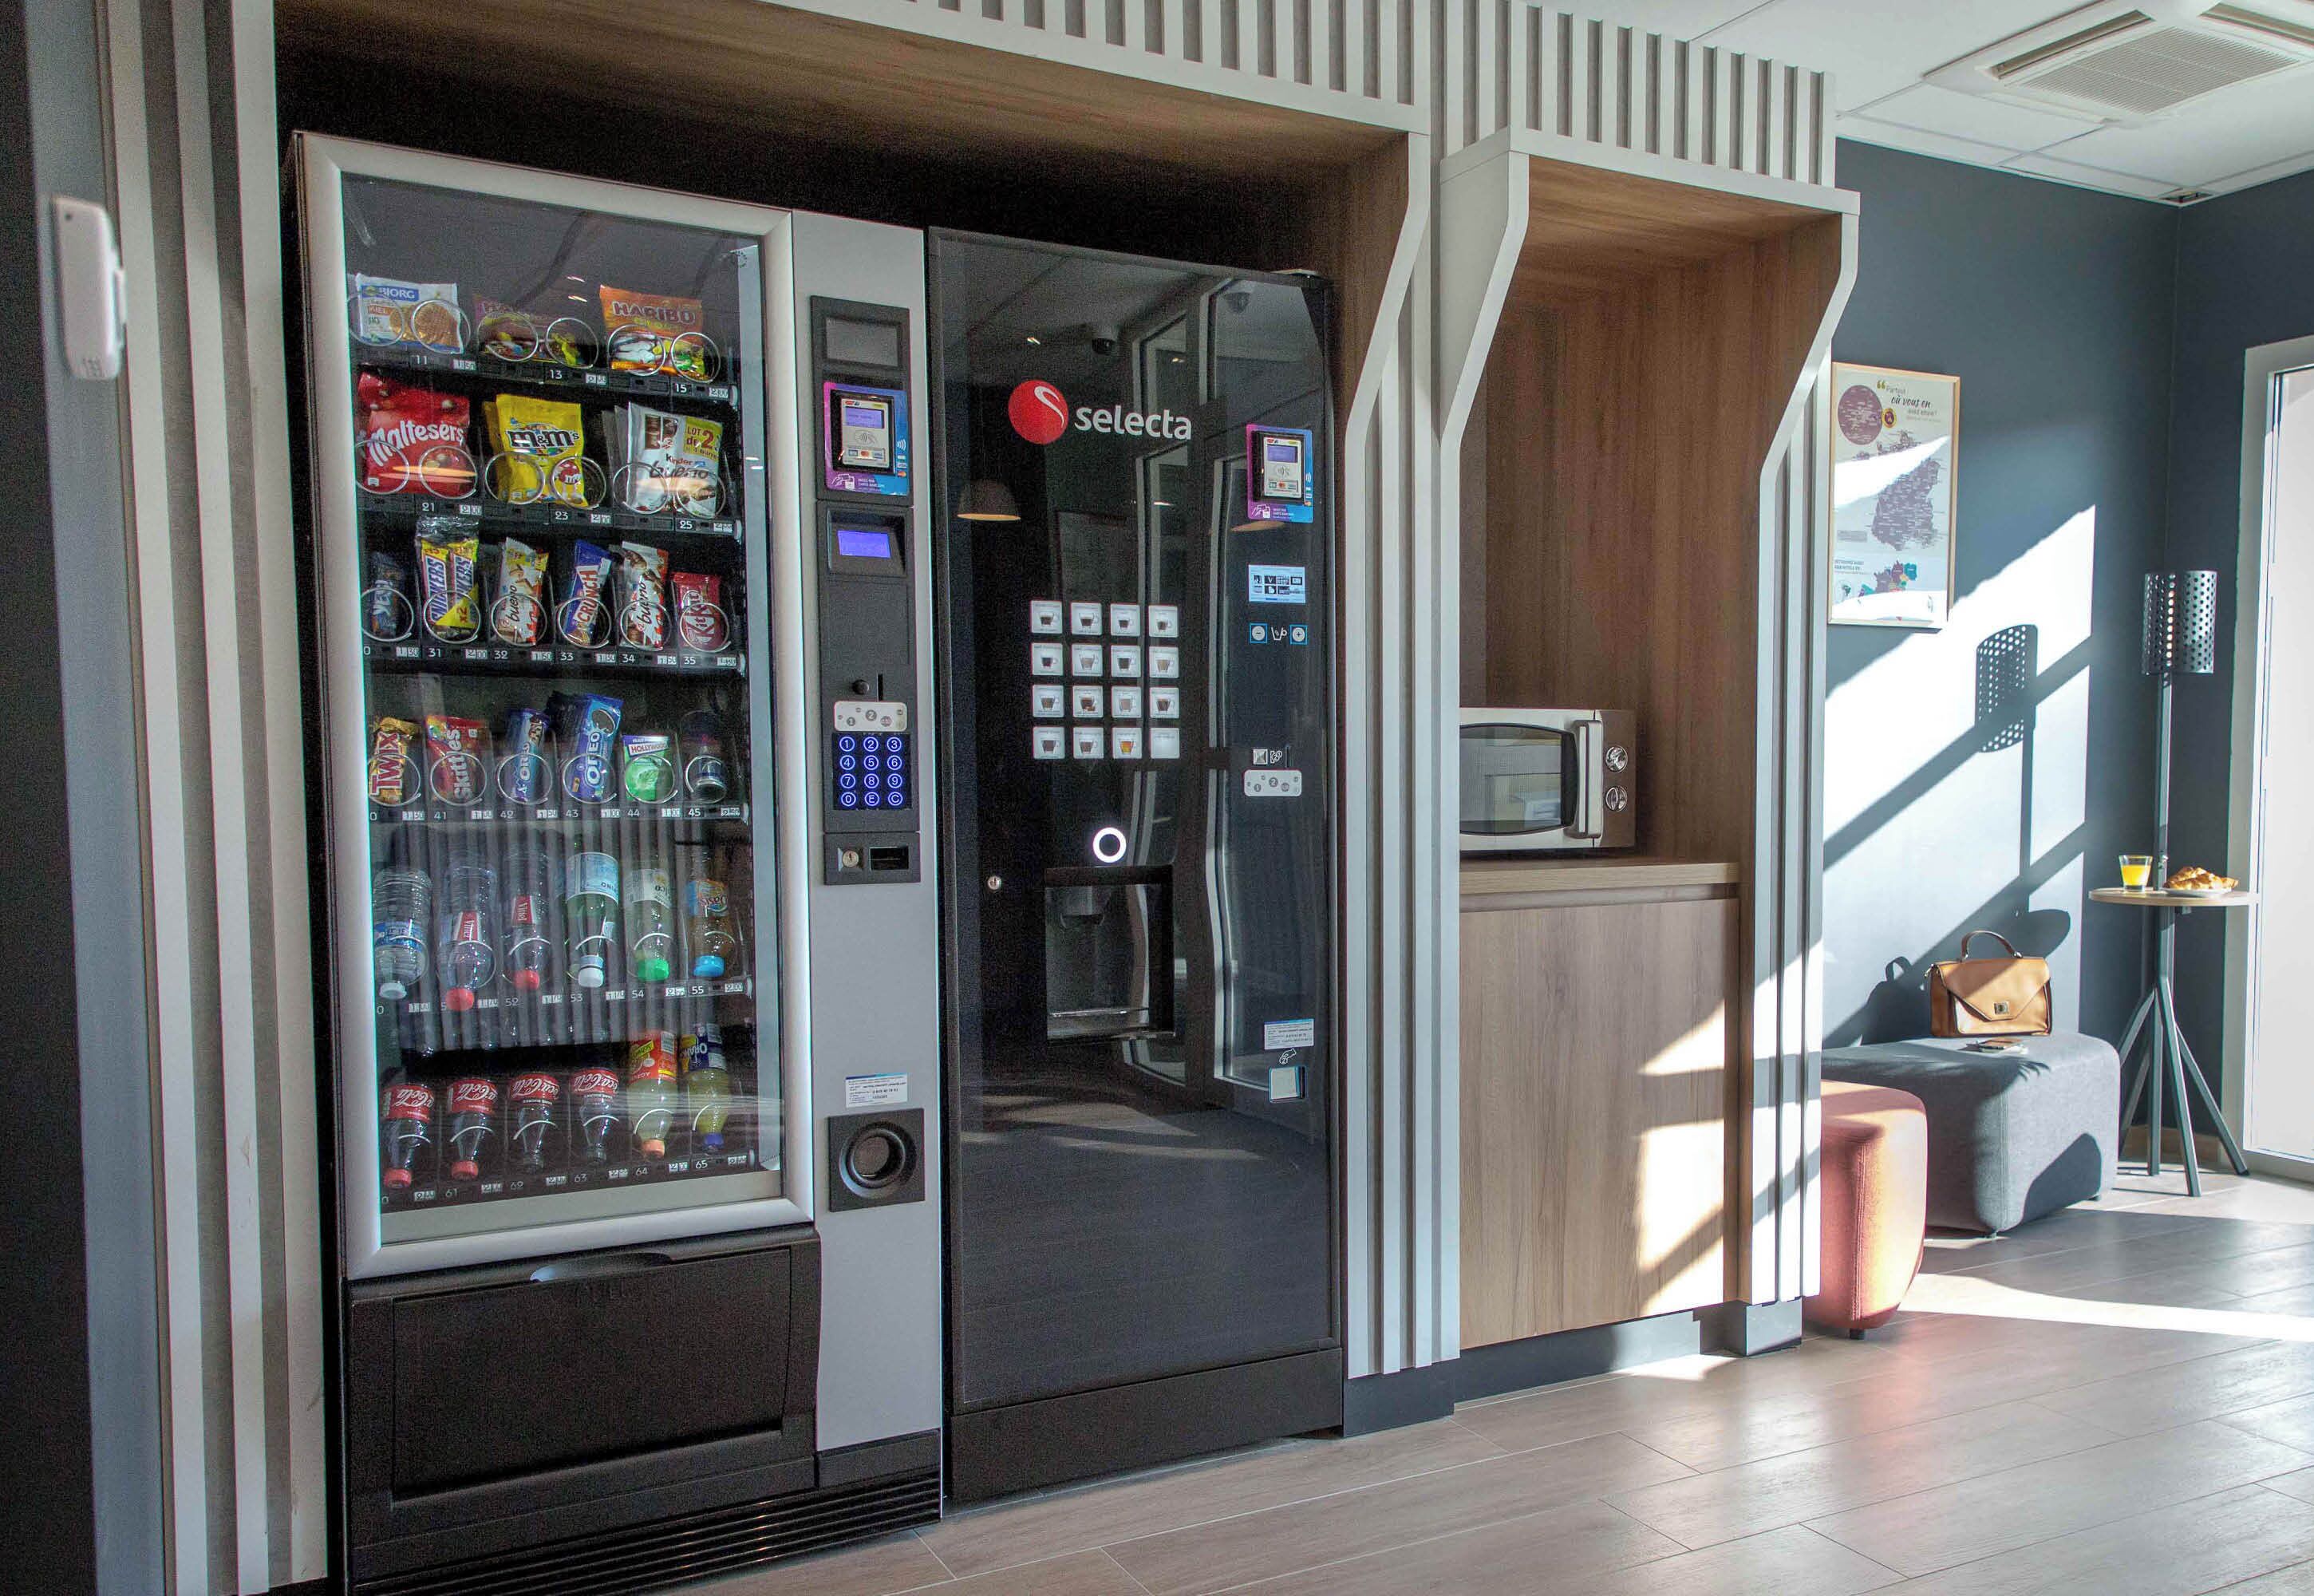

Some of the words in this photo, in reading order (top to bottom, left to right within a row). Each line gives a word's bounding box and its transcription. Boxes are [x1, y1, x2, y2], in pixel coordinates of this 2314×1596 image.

[612, 301, 697, 325] HARIBO
[551, 369, 563, 379] 13
[675, 384, 687, 394] 15
[1074, 405, 1192, 440] selecta
[366, 420, 466, 467] Maltesers
[421, 502, 434, 512] 21
[555, 512, 569, 520] 23
[679, 520, 693, 530] 25
[426, 558, 448, 623] SNICKERS
[576, 570, 598, 625] CRUNCH
[506, 585, 519, 622] bueno
[637, 583, 653, 625] bueno
[428, 648, 441, 657] 31
[494, 650, 508, 659] 32
[559, 653, 574, 662] 33
[622, 654, 635, 663] 34
[683, 656, 697, 665] 35
[844, 740, 849, 749] 1
[867, 740, 874, 749] 2
[891, 740, 898, 749] 3
[369, 730, 403, 796] TWIX
[586, 731, 602, 786] OREO
[843, 758, 851, 767] 4
[868, 758, 875, 768] 5
[891, 758, 898, 768] 6
[844, 776, 851, 786] 7
[868, 776, 875, 786] 8
[892, 776, 898, 786] 9
[845, 795, 851, 804] 0
[869, 795, 875, 804] E
[892, 795, 899, 804] C
[434, 811, 447, 820] 41
[628, 808, 640, 817] 44
[688, 808, 701, 817] 45
[632, 990, 645, 998] 54
[692, 986, 705, 994] 55
[570, 994, 583, 1002] 53
[696, 1159, 708, 1169] 65
[636, 1167, 648, 1175] 64
[574, 1173, 586, 1183] 63
